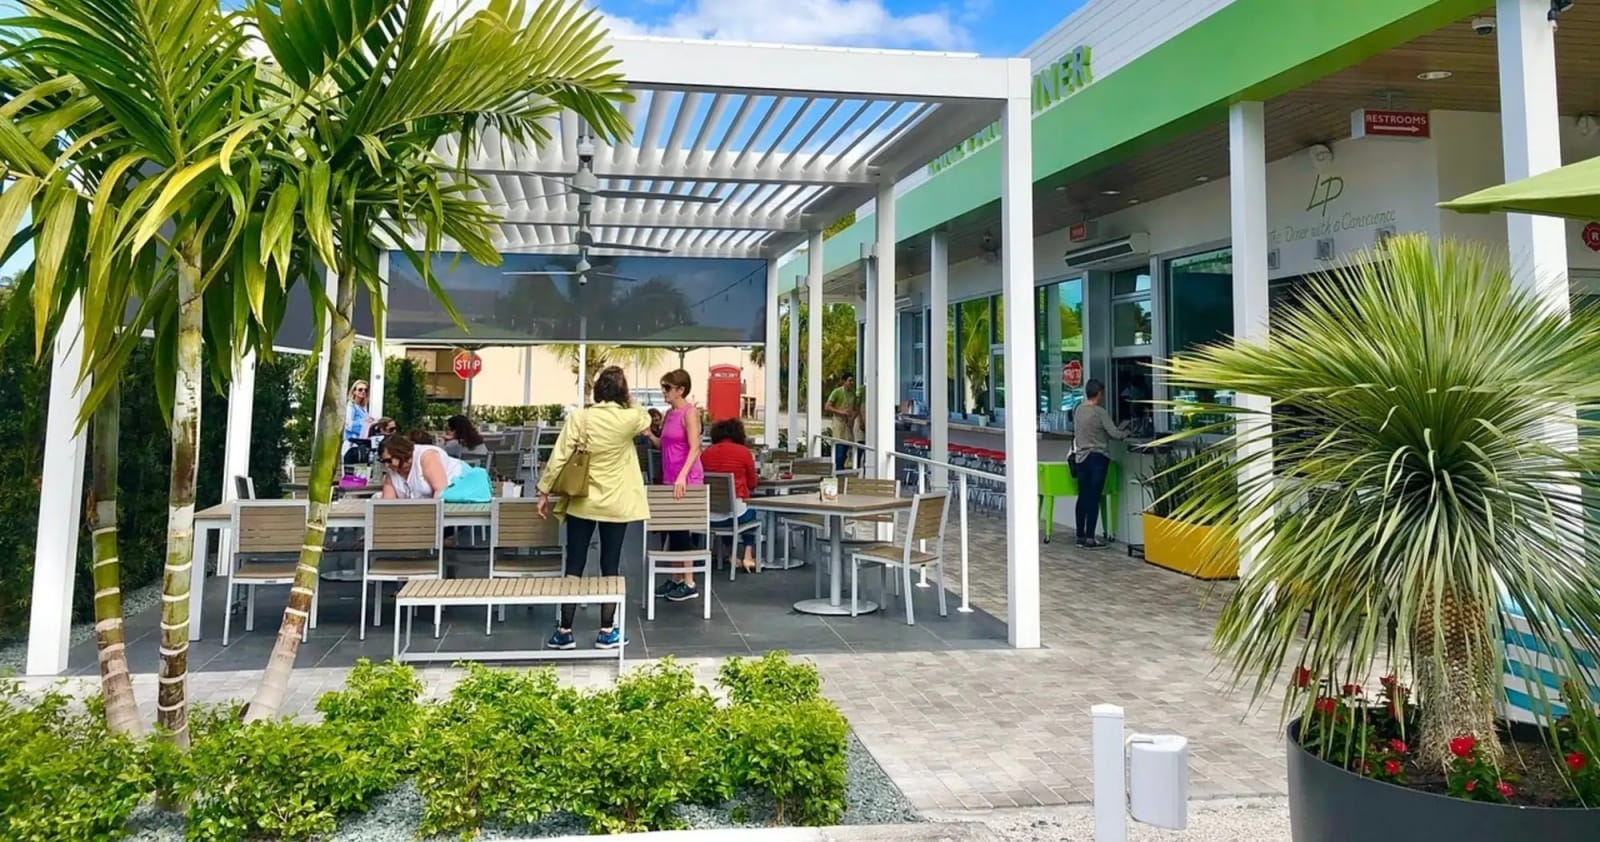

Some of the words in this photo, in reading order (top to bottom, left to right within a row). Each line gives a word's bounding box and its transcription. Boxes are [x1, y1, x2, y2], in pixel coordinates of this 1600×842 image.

[1031, 45, 1093, 112] INER
[1366, 114, 1426, 125] RESTROOMS
[1306, 174, 1344, 217] LP
